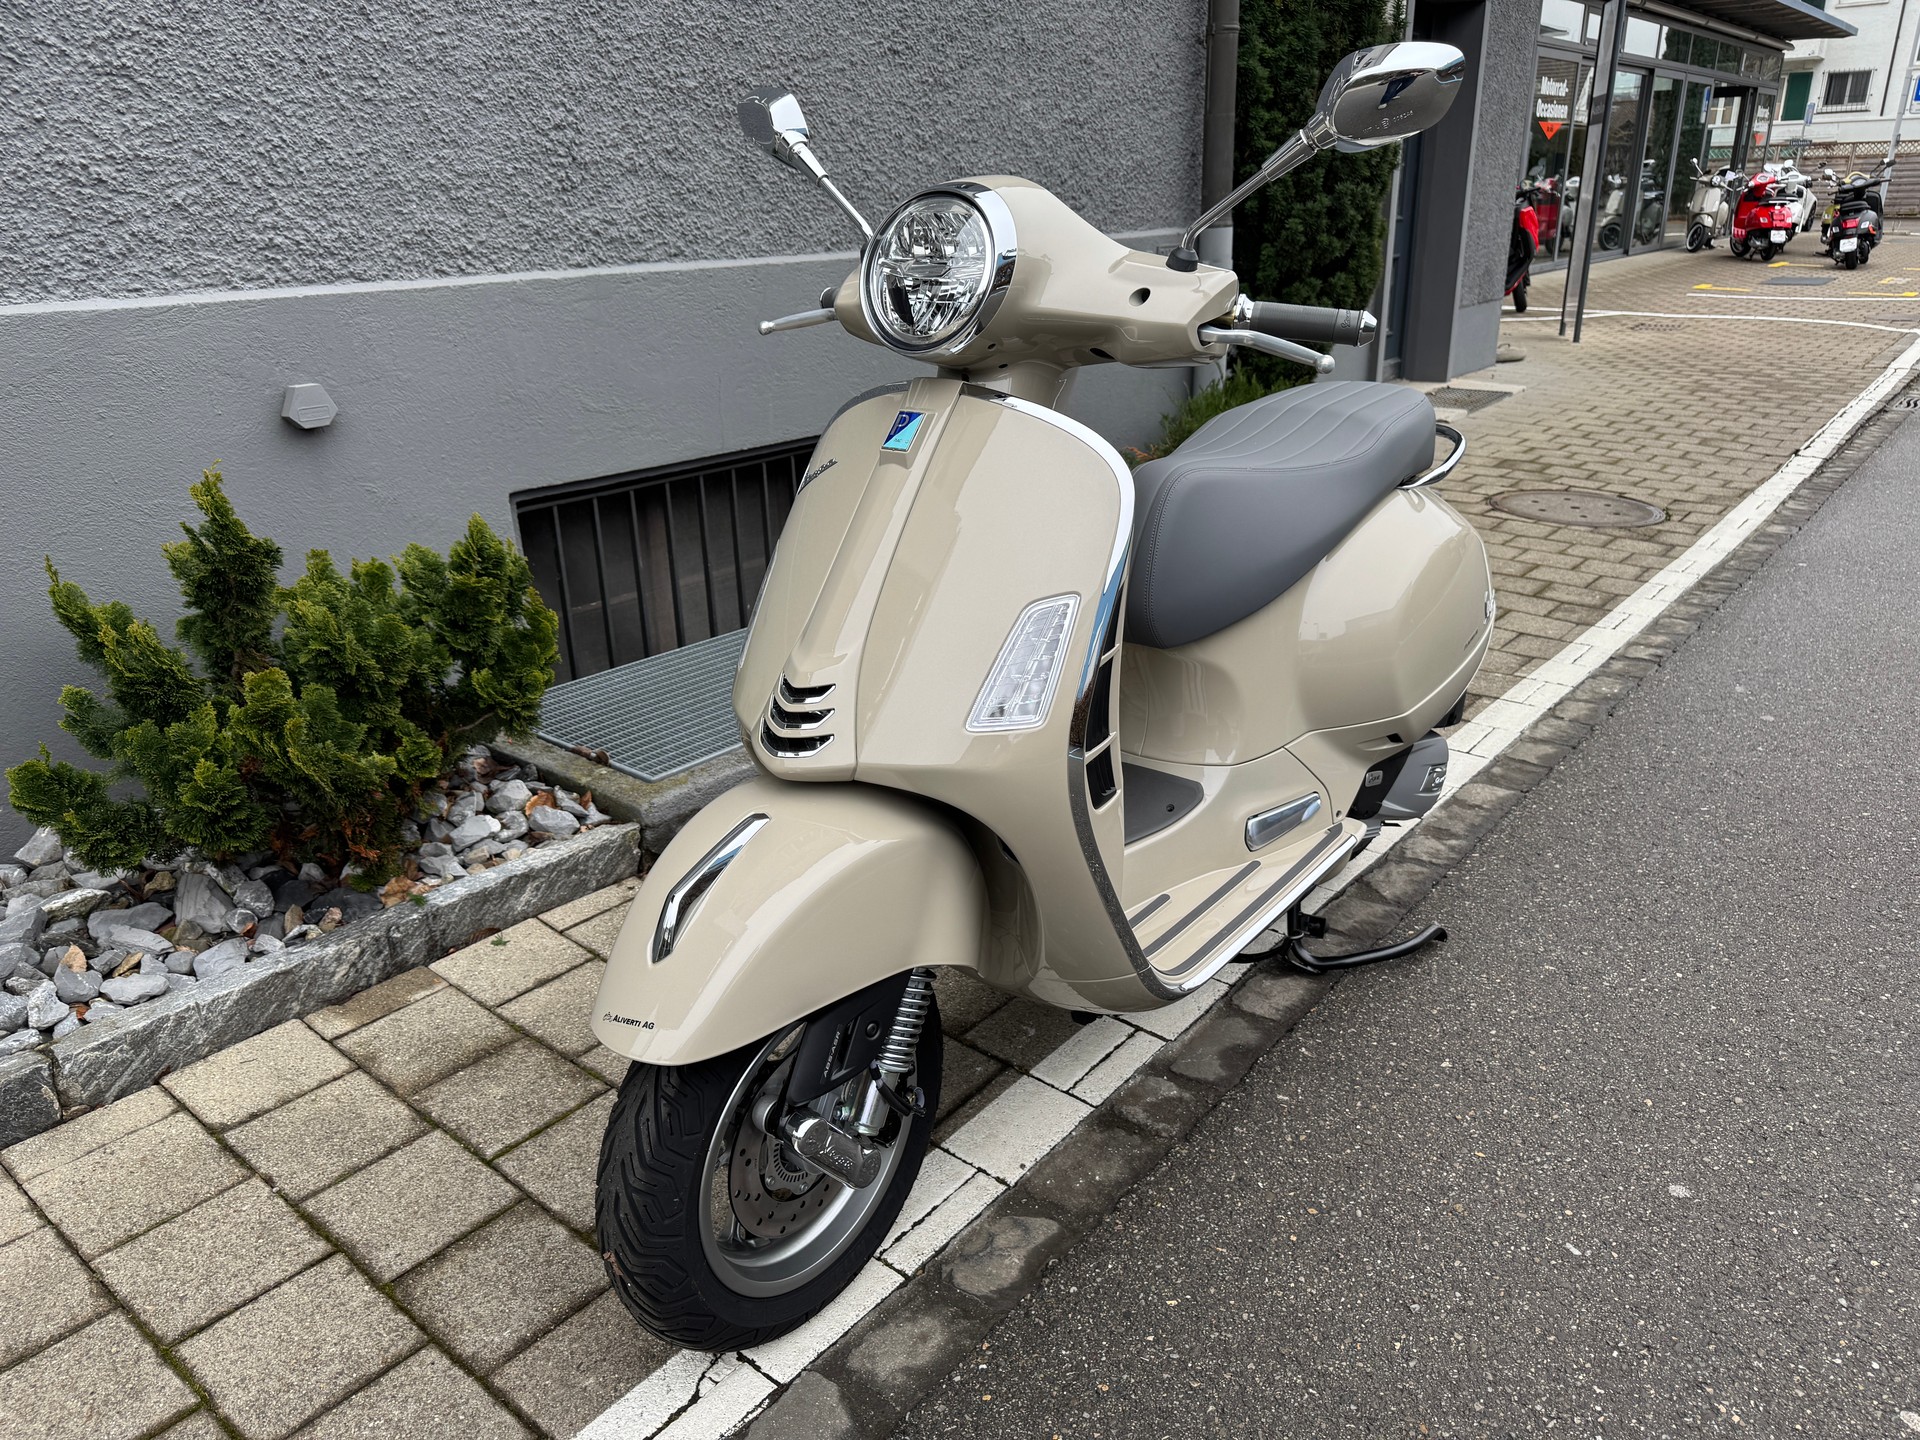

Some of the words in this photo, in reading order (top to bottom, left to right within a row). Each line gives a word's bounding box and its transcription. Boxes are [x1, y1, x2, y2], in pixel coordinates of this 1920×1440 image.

[1541, 76, 1569, 97] Motorrad-
[1536, 98, 1568, 119] Occasionen
[890, 414, 910, 436] P
[612, 1014, 642, 1028] ALIVERTI
[641, 1021, 655, 1030] AG
[823, 1031, 841, 1078] ABS-ASR
